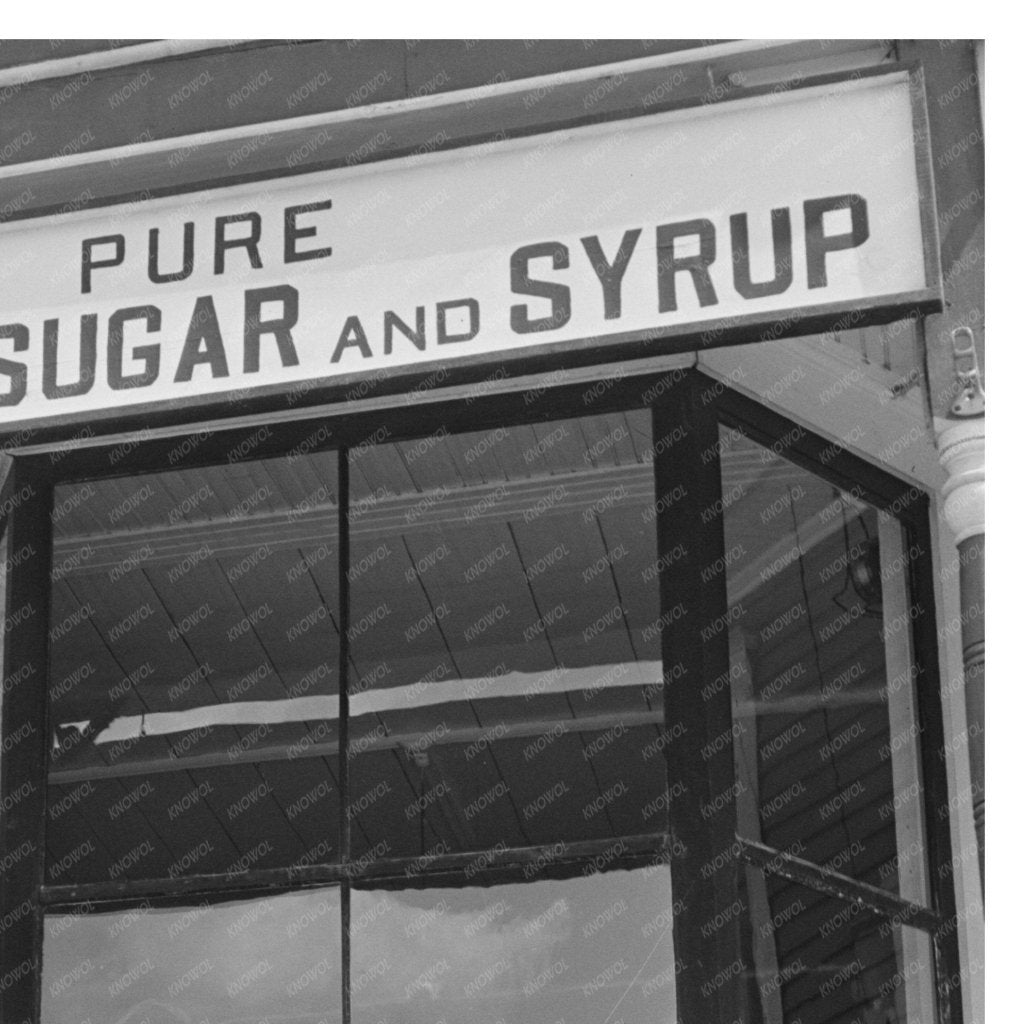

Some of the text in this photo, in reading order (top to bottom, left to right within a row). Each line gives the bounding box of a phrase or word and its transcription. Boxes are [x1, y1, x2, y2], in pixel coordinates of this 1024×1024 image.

[80, 199, 333, 294] PURE
[329, 298, 480, 363] AND
[508, 193, 870, 335] SYRUP
